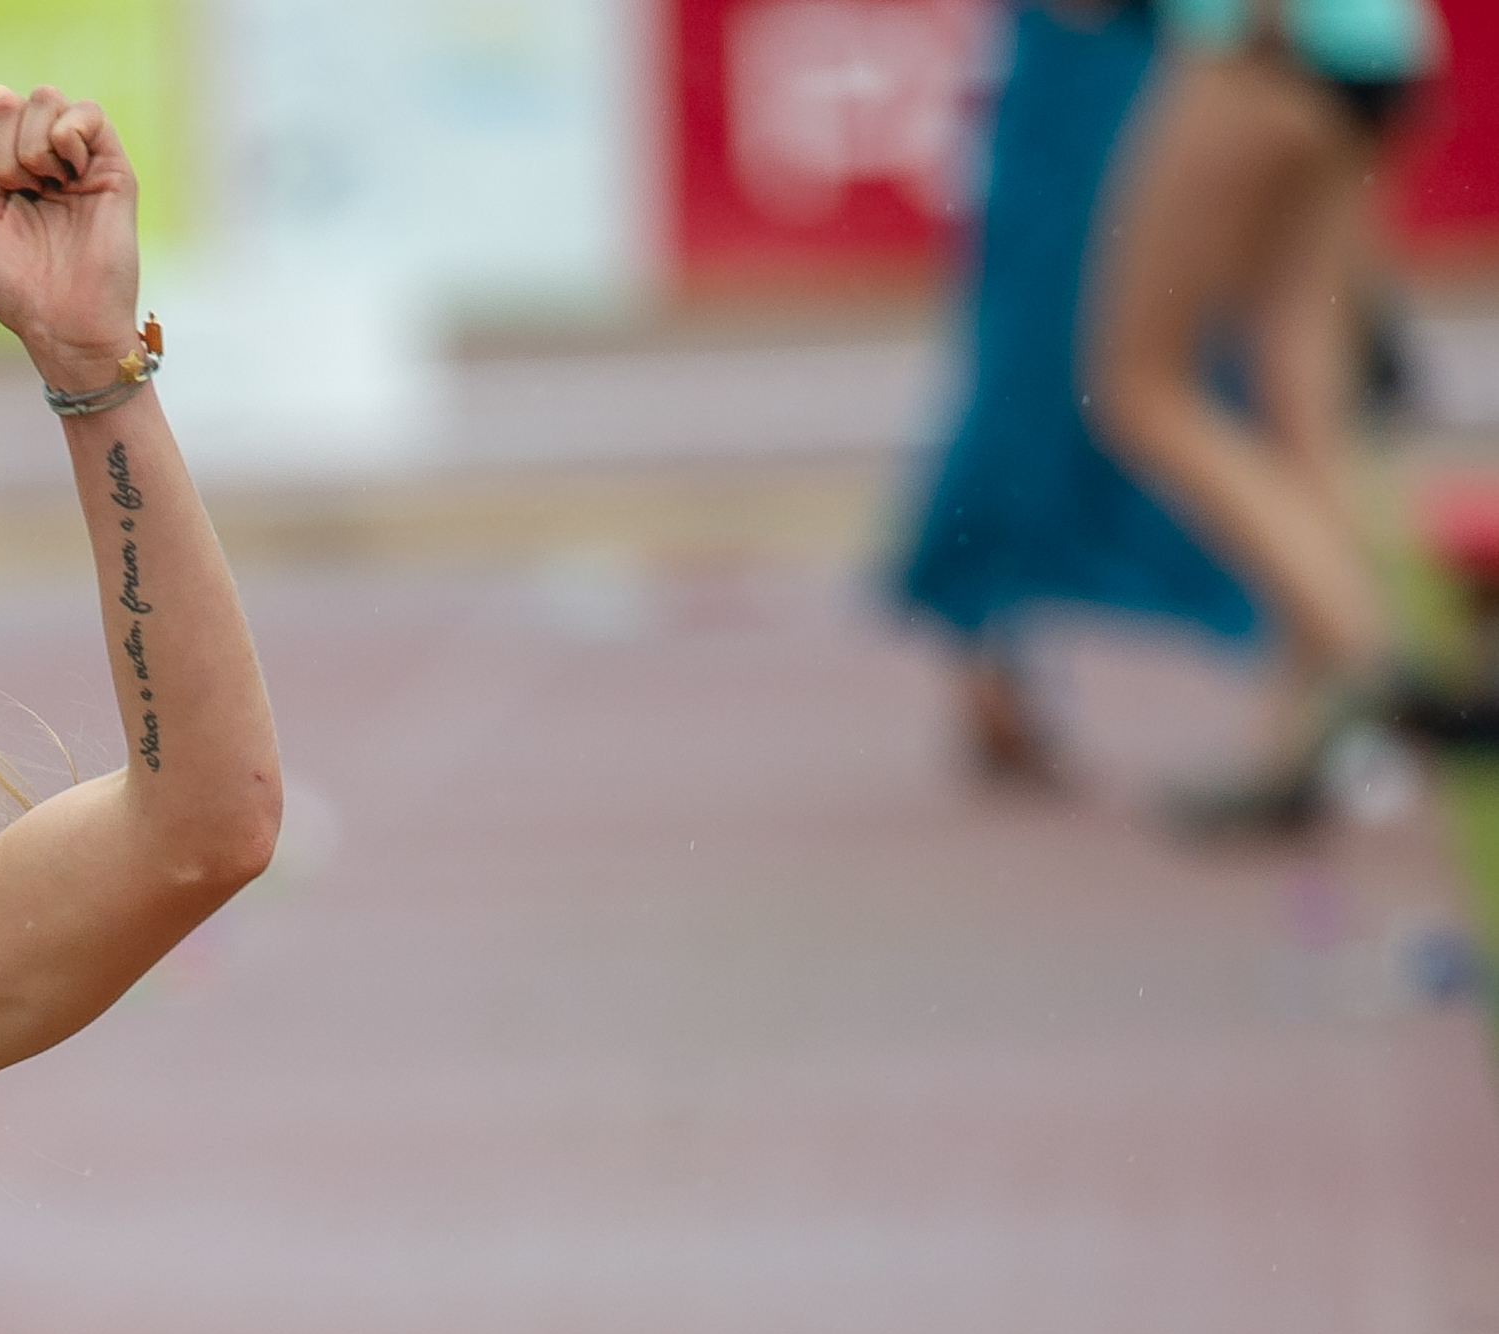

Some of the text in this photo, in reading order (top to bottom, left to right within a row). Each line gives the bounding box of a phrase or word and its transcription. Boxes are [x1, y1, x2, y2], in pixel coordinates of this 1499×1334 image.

[106, 440, 144, 511] fighter
[120, 516, 136, 533] a
[119, 538, 154, 615] forever
[140, 687, 154, 702] a
